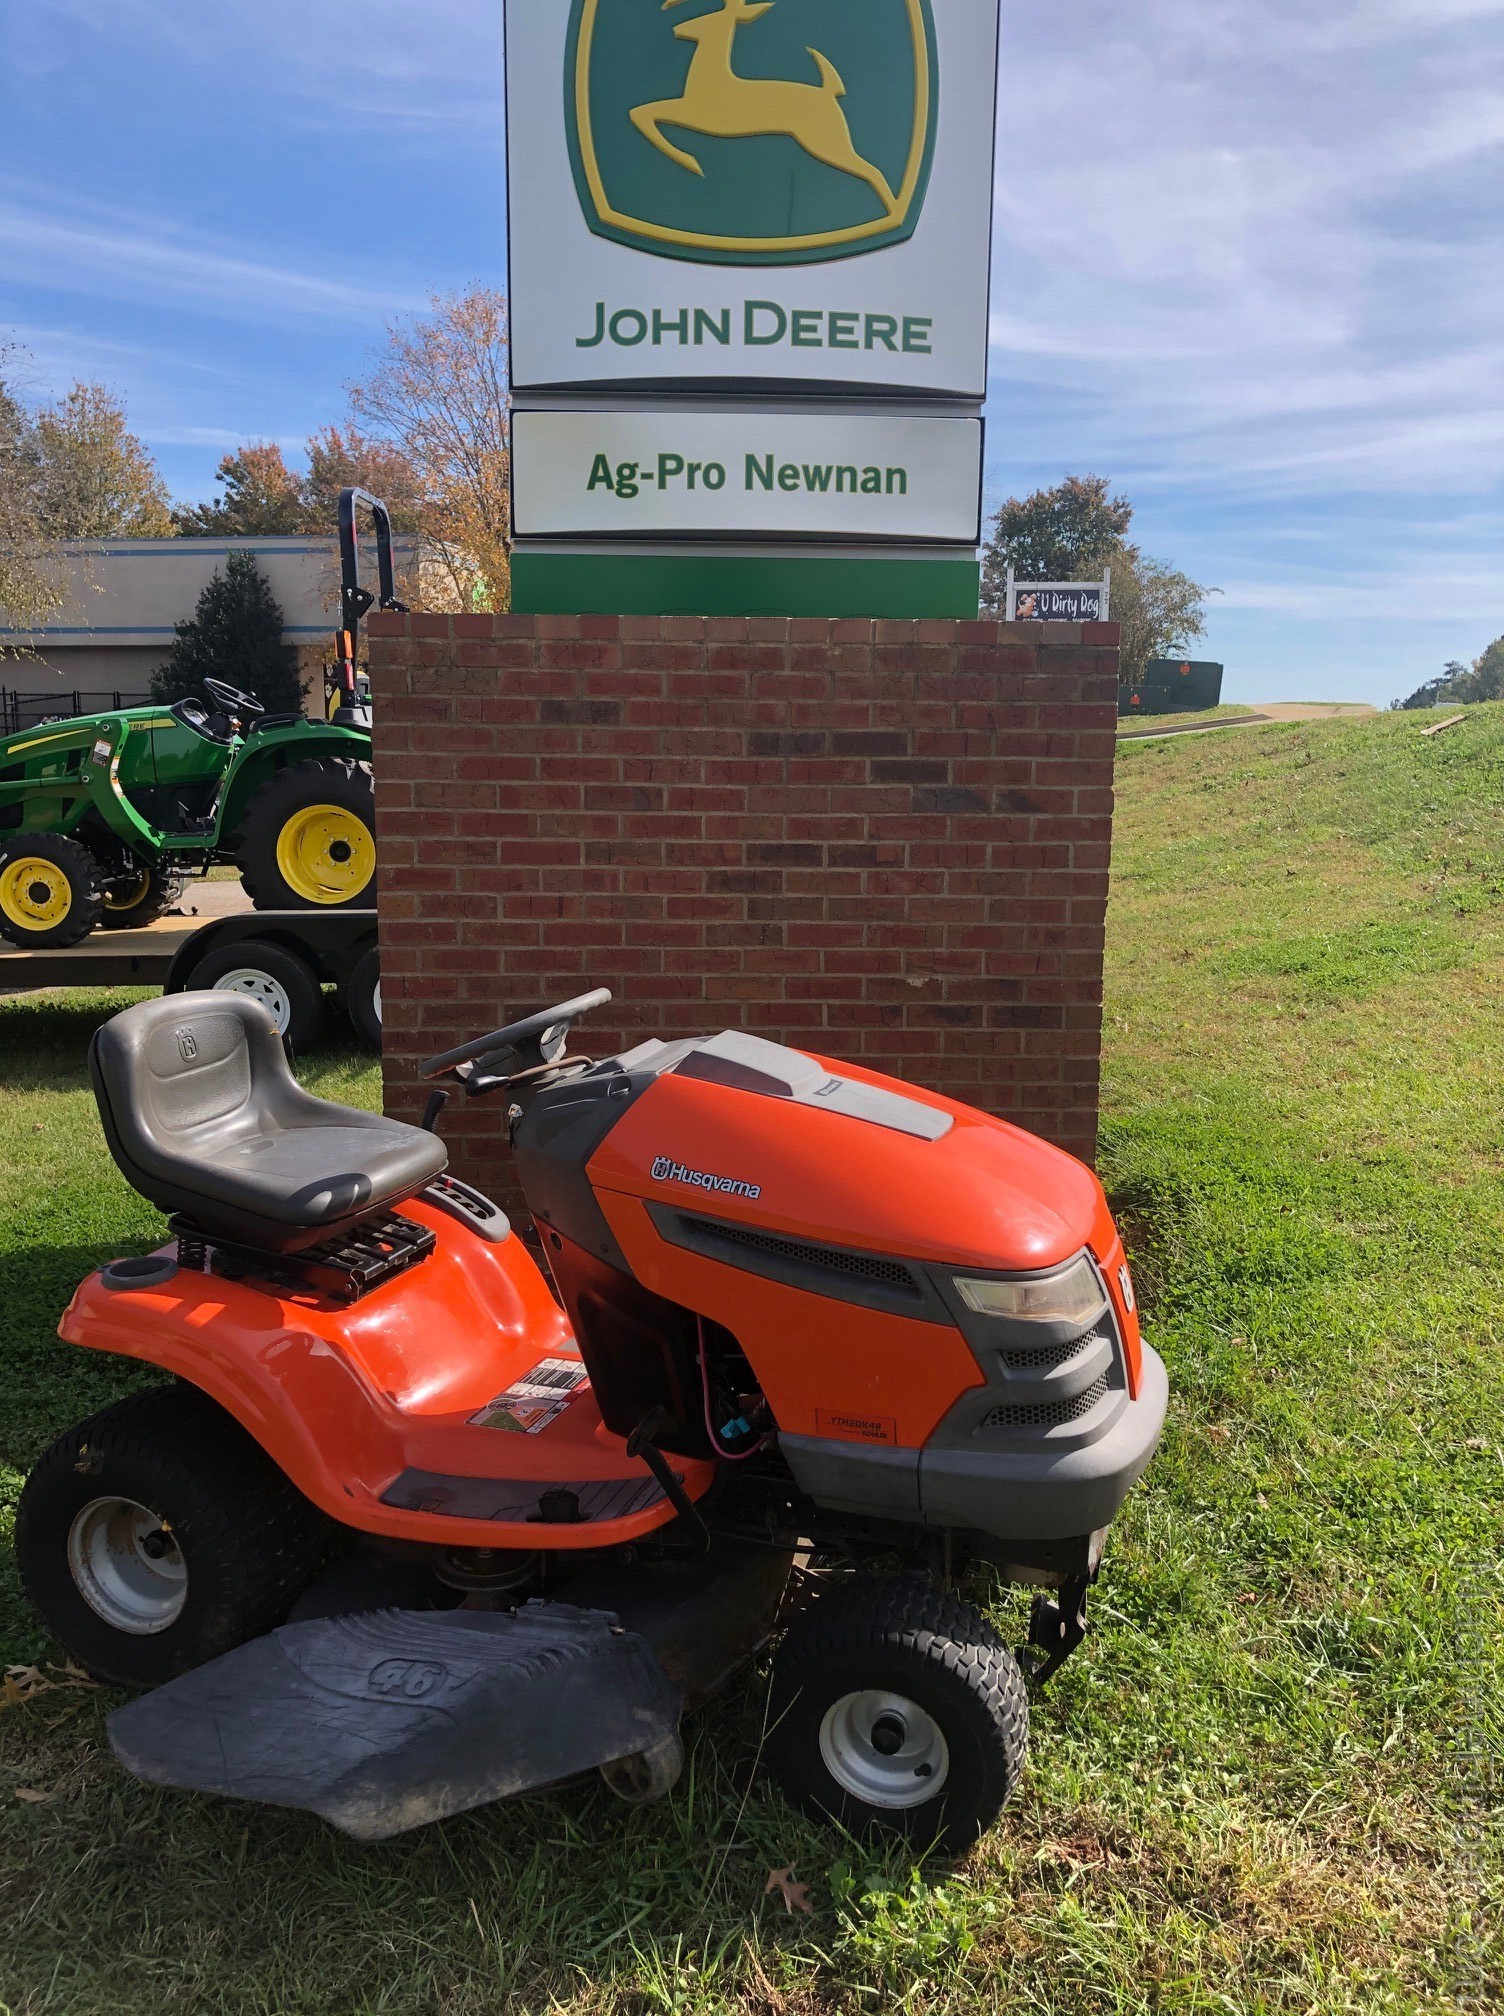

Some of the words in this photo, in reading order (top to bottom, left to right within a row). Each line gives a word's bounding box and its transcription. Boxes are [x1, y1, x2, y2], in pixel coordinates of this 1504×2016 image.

[575, 300, 731, 348] JOHN
[743, 299, 935, 355] DEERE
[586, 452, 727, 499] Ag-Pro
[744, 452, 908, 496] Newnan
[1052, 591, 1077, 617] Dirty
[1080, 591, 1099, 619] Dog
[669, 1162, 762, 1200] Husqvarna
[369, 1666, 443, 1697] 46
